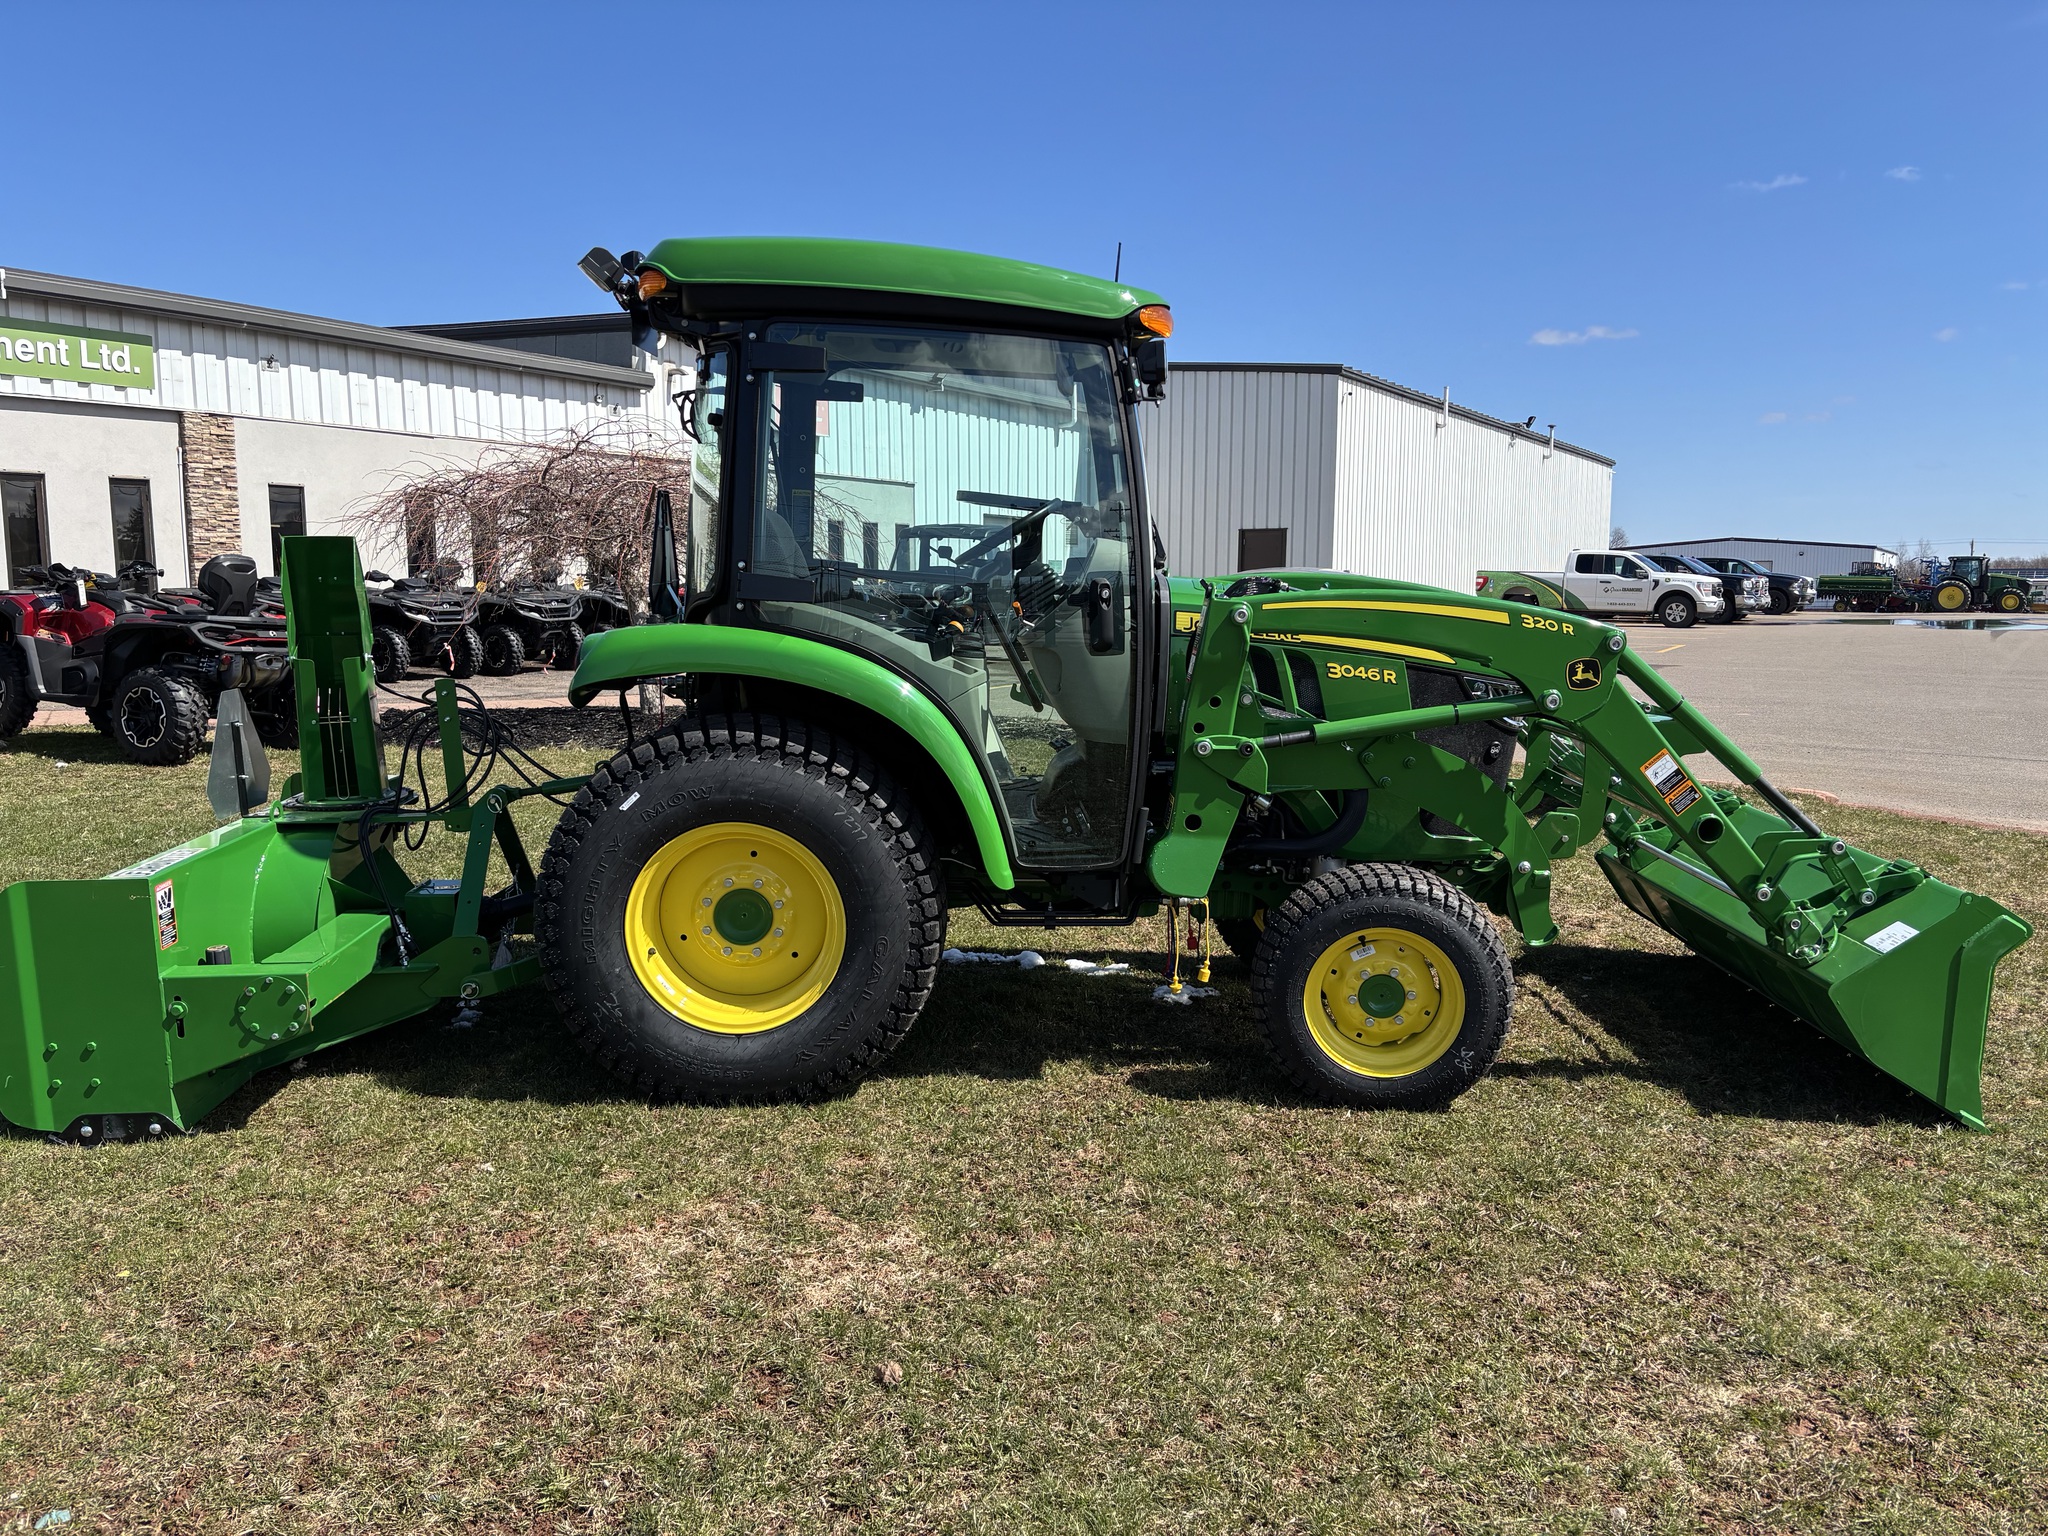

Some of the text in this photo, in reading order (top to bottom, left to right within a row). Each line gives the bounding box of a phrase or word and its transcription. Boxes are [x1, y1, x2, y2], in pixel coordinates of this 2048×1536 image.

[79, 339, 141, 374] Ltd.
[1520, 613, 1576, 636] 320 R
[1326, 662, 1398, 685] 3046 R
[581, 833, 623, 964] MIGHTY
[641, 785, 715, 822] MOW
[1341, 903, 1457, 936] GALAXY
[793, 935, 890, 1068] GALAXY
